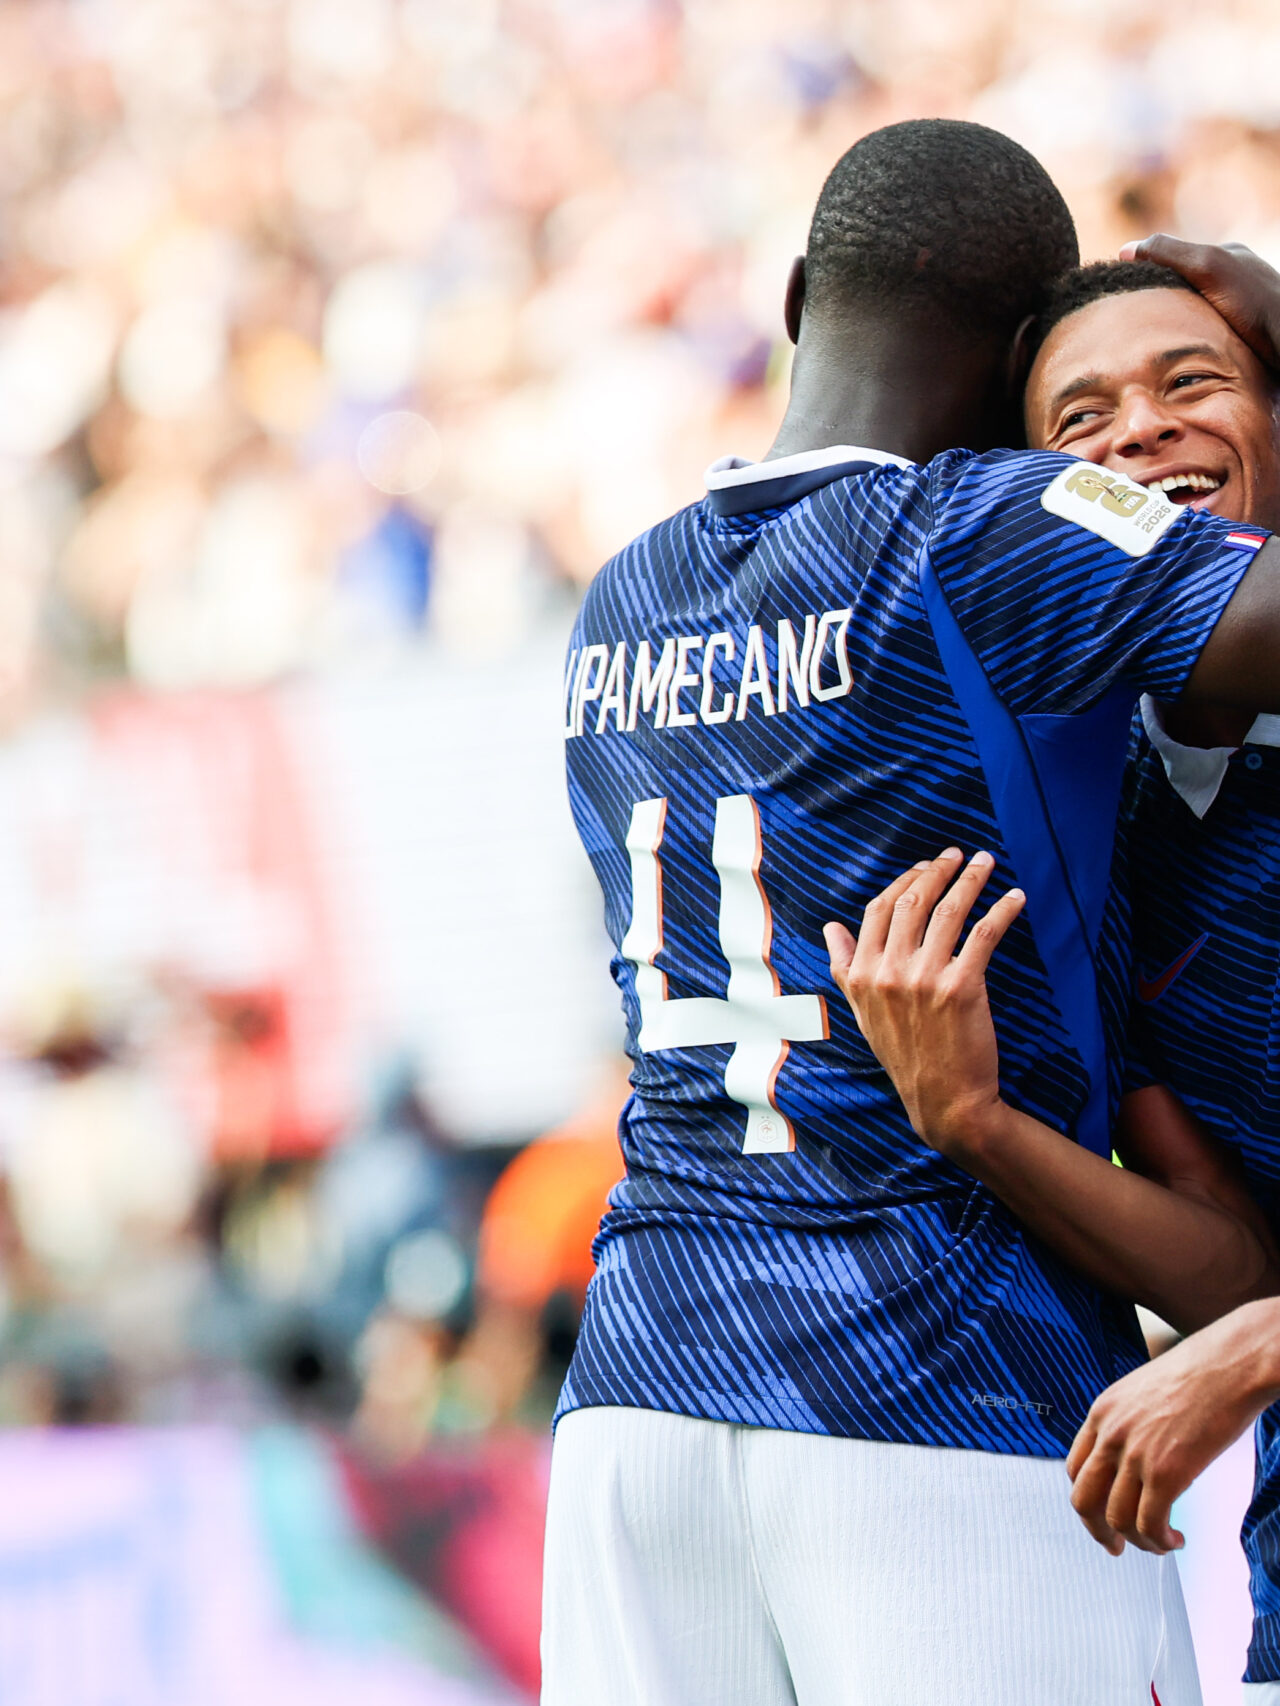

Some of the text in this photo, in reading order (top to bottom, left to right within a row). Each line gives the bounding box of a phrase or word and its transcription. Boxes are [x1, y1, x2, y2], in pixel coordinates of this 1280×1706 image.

[1141, 505, 1171, 534] 2026
[564, 608, 854, 740] UPAMECANO
[621, 793, 831, 1155] 4
[971, 1394, 1054, 1416] AERO-FIT
